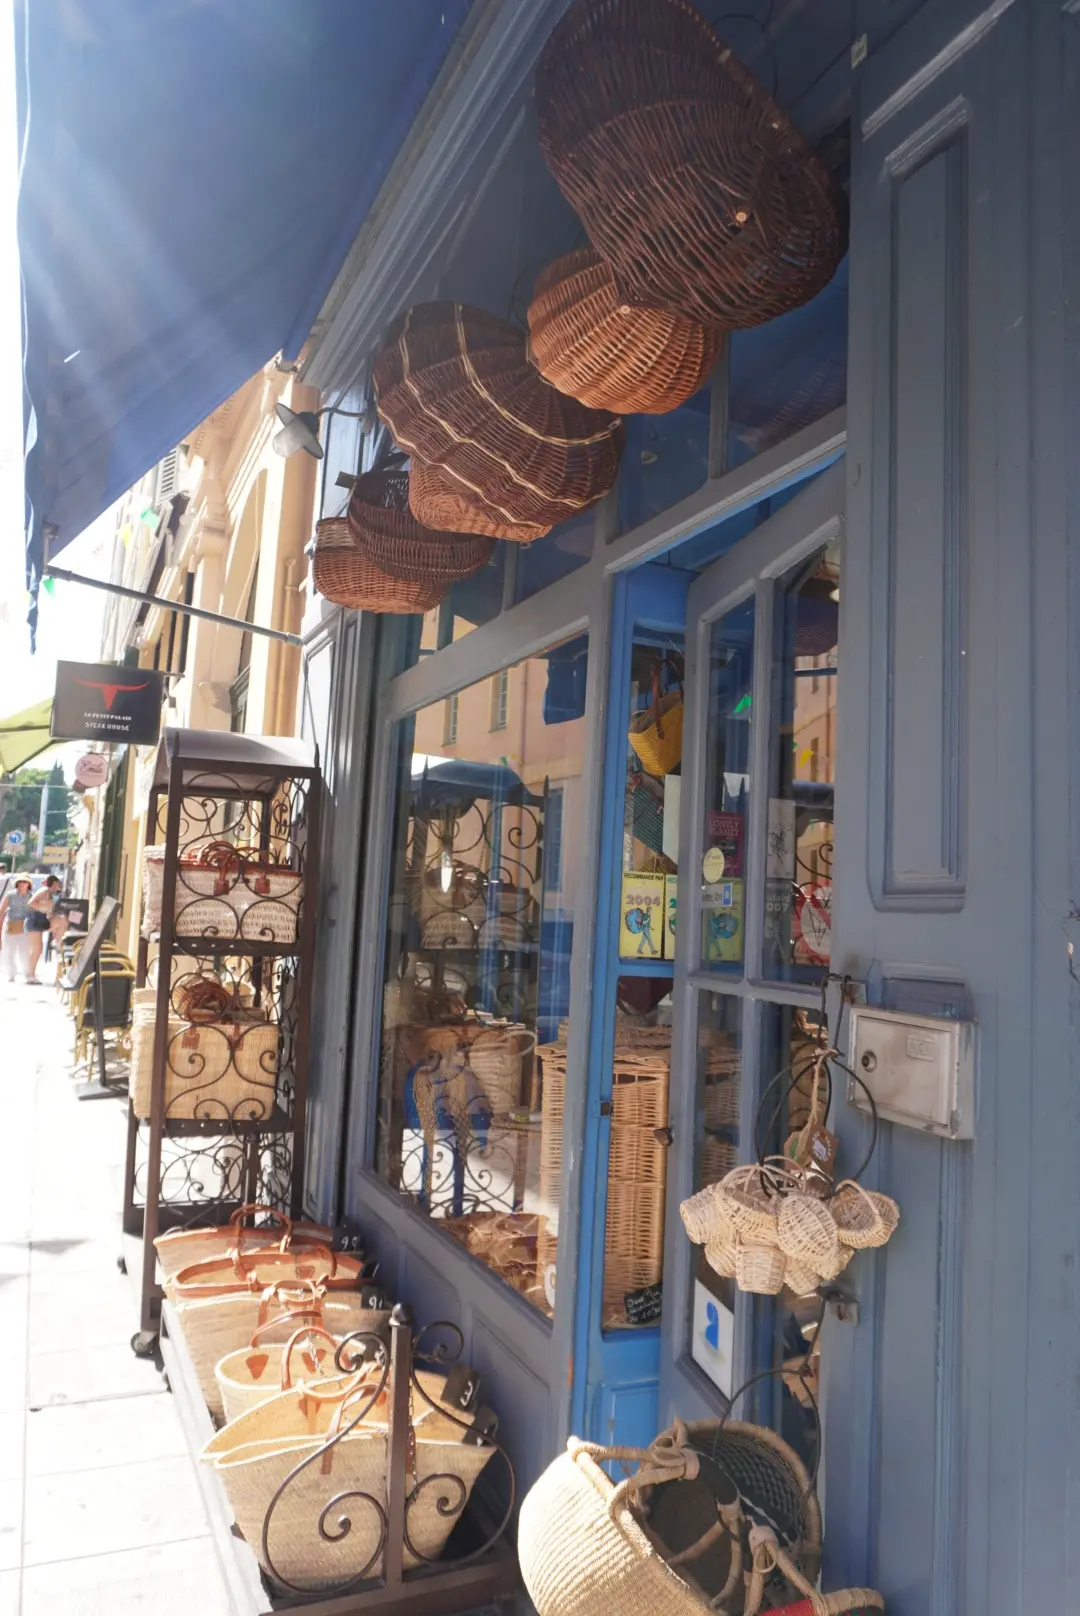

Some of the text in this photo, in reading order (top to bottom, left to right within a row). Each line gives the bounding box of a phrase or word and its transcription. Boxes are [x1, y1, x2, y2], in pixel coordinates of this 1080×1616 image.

[85, 721, 130, 731] STEAK HOUSE
[709, 819, 740, 829] LONELY
[709, 826, 740, 837] PLANET
[625, 894, 661, 907] 2004
[766, 902, 789, 912] 007
